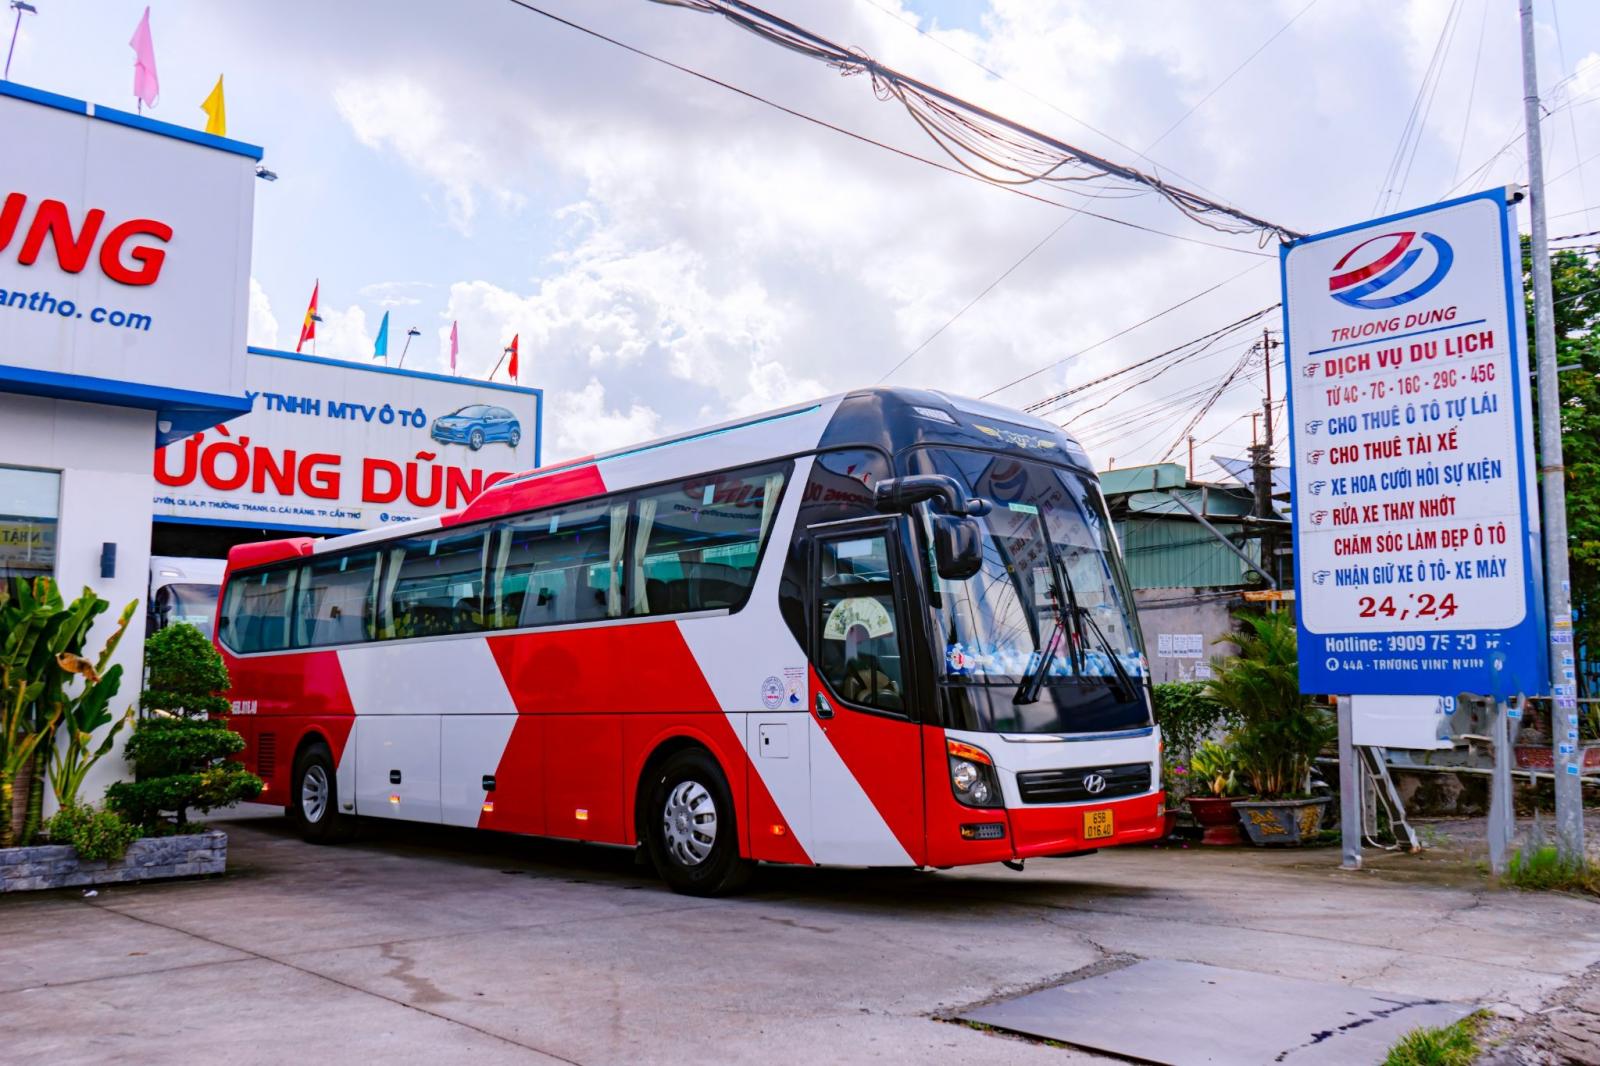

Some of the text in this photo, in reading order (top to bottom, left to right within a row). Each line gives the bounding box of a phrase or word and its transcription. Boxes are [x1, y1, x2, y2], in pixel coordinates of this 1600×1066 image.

[1331, 306, 1457, 342] TRUONG DUNG
[1324, 331, 1494, 378] DỊCH VỤ DU LỊCH
[1344, 386, 1358, 403] 4C
[1370, 381, 1385, 400] 7C
[1398, 375, 1420, 396] 16C
[1433, 369, 1457, 390] 29C
[1470, 363, 1495, 383] 45C
[262, 392, 320, 416] TNHH
[328, 400, 376, 423] MTV
[379, 403, 395, 424] Ô
[398, 407, 427, 429] TÔ
[1328, 391, 1497, 435] CHO THUÊ Ô TÔ TỰ LÁI
[1329, 425, 1458, 465] CHO THUÊ TÀI XẾ
[1331, 457, 1502, 496] XE HOA CƯỚI HỎI SỰ KIỆN
[1333, 494, 1456, 526] RỬA XE THAY NHỚT
[1334, 521, 1506, 556] CHĂM SÓC LÀM ĐẸP Ô TÔ
[1335, 564, 1369, 589] NHẬN
[1372, 562, 1394, 584] GIỮ
[1397, 564, 1413, 583] XE
[1417, 560, 1425, 582] Ô
[1455, 560, 1472, 580] XE
[1476, 554, 1507, 578] MÁY
[1325, 636, 1383, 652] Hotline:
